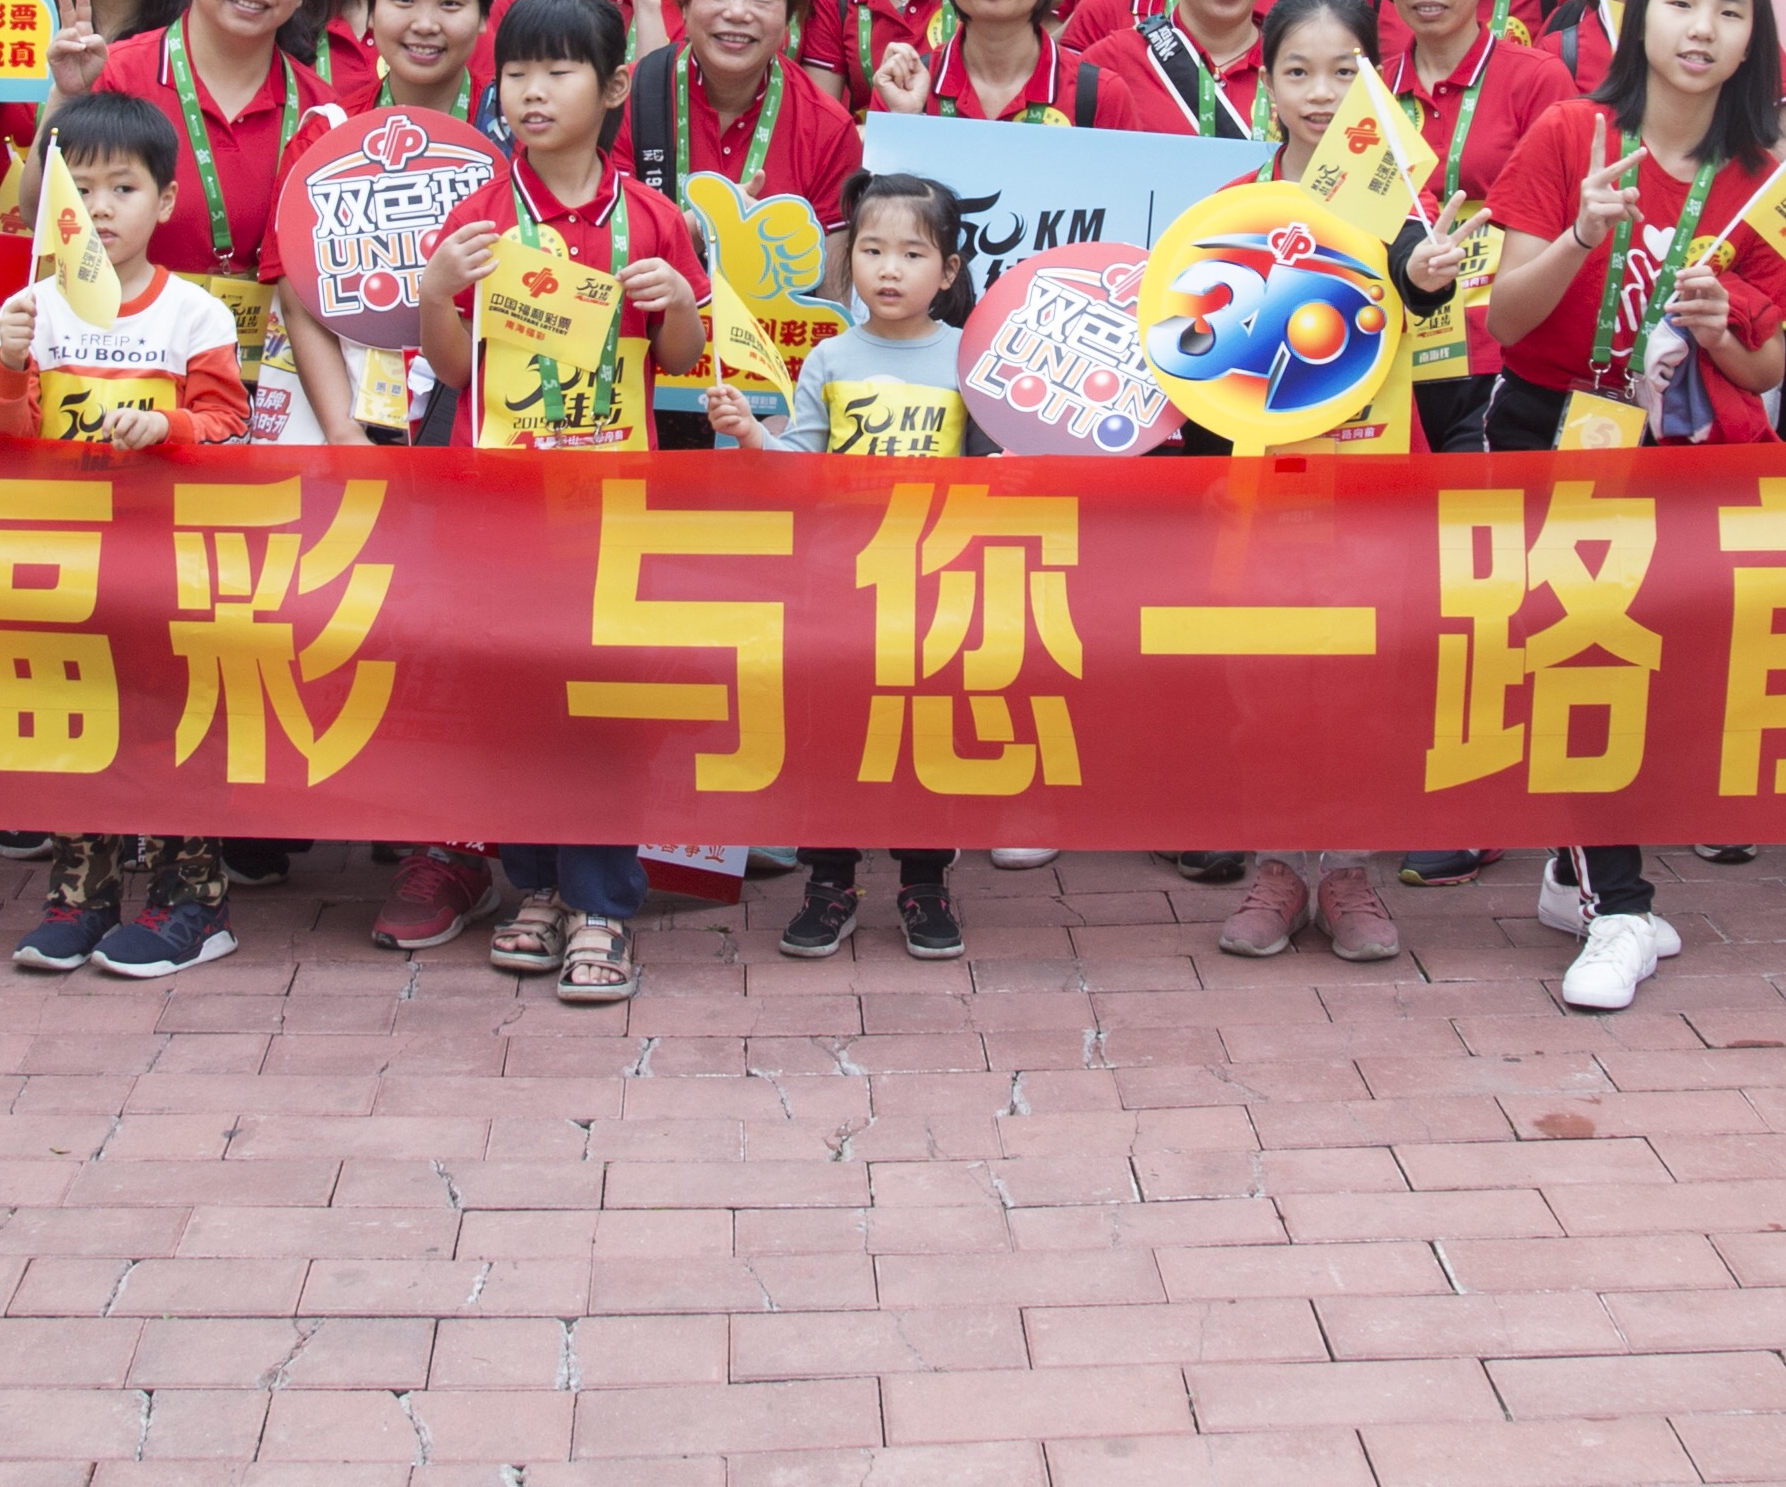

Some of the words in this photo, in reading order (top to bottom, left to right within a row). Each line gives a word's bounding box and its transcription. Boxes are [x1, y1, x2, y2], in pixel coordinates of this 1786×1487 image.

[490, 292, 572, 331] 中国福利彩票
[1011, 274, 1157, 386] 双色
[965, 350, 1139, 453] LOTTO
[992, 324, 1170, 428] UNION
